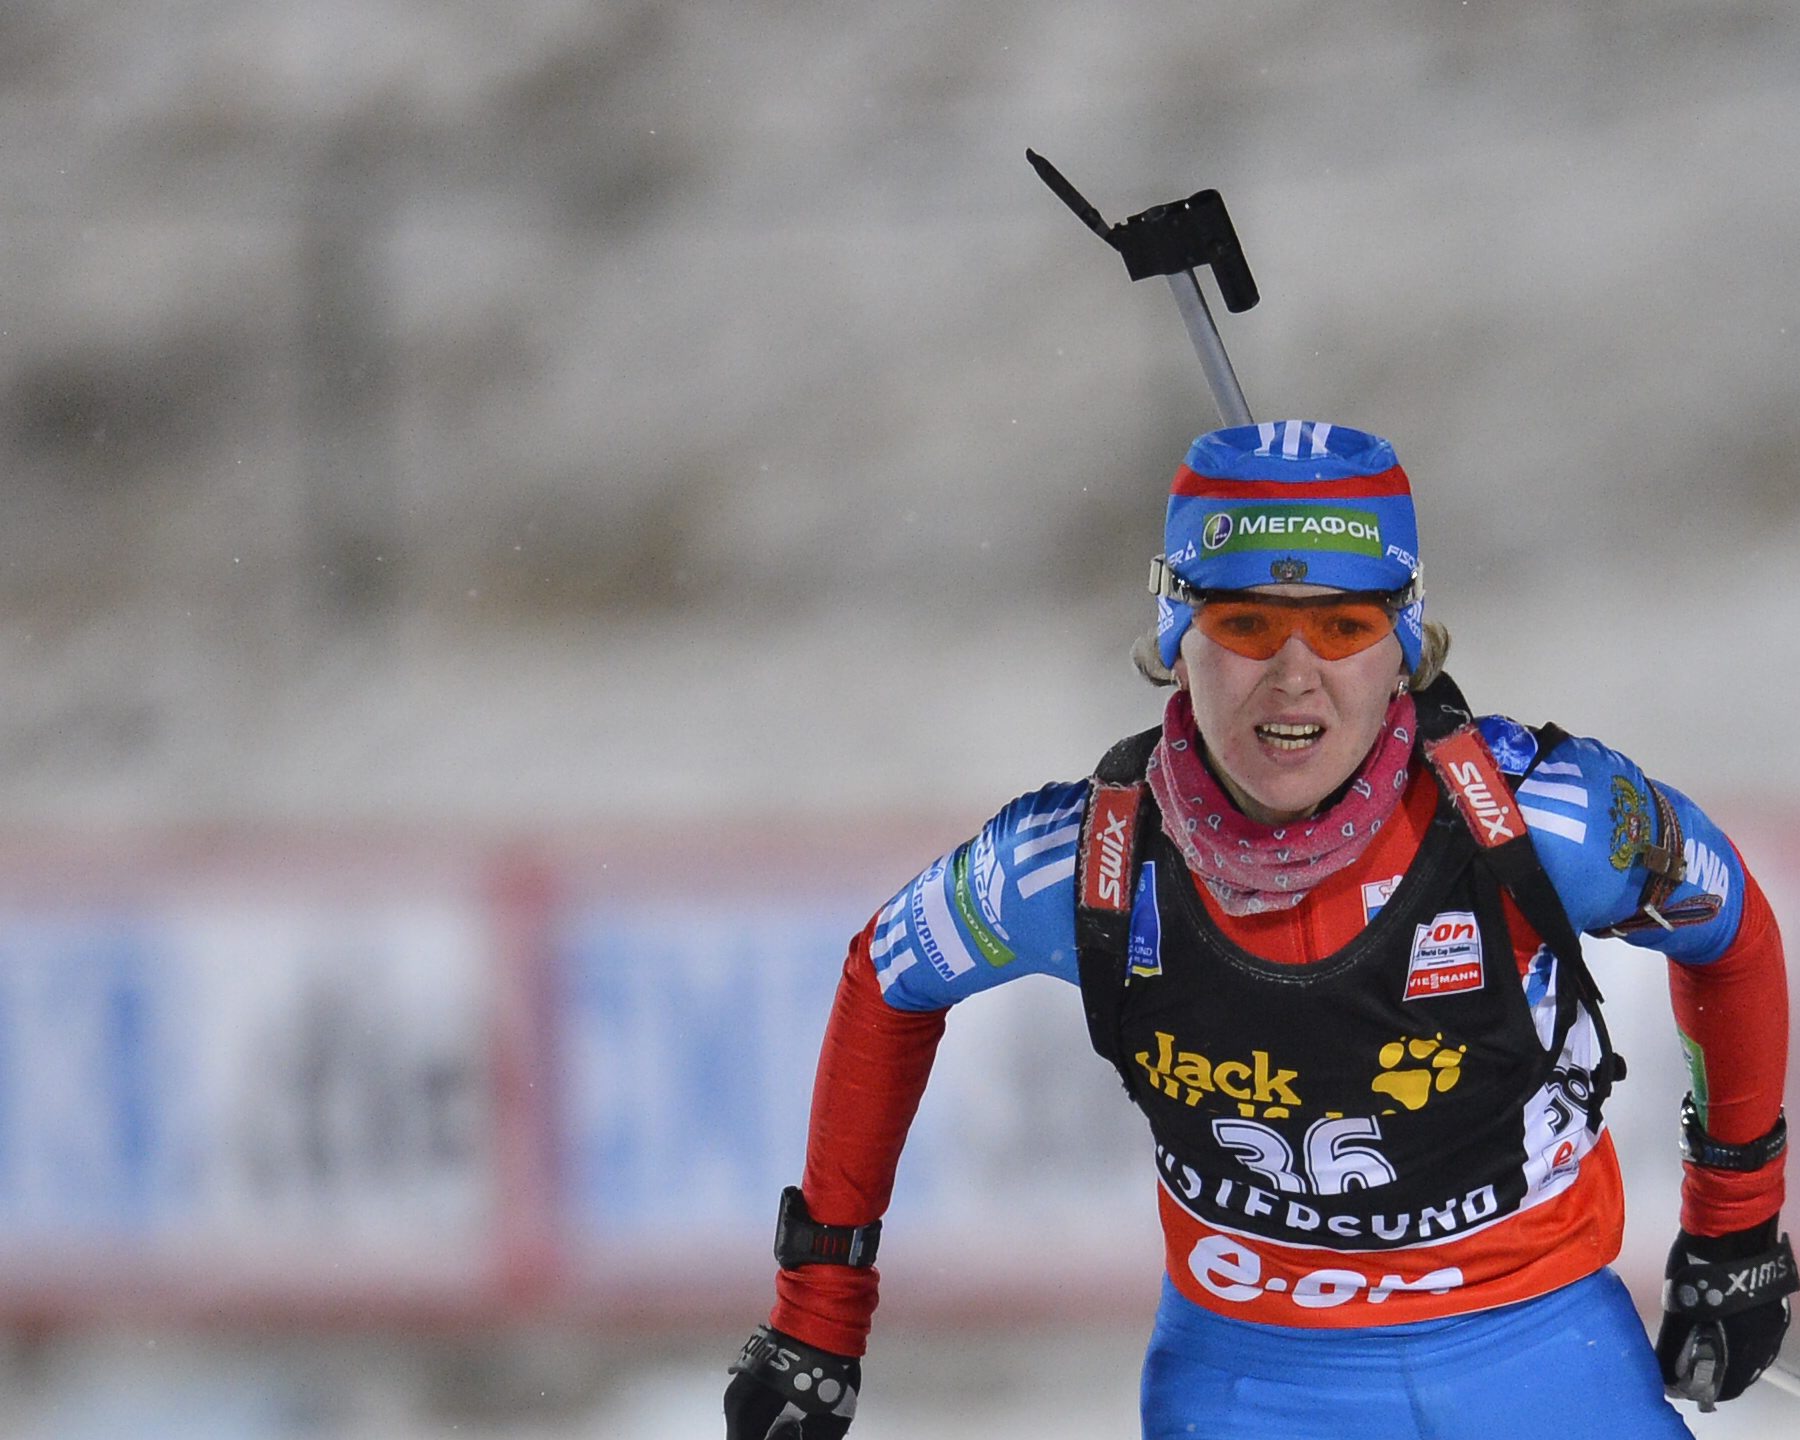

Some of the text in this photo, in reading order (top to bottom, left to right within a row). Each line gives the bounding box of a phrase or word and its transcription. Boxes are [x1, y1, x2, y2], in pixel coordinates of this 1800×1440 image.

[1238, 514, 1380, 543] МЕГАФОН
[1135, 1031, 1302, 1105] Jack
[1211, 1114, 1398, 1196] 36
